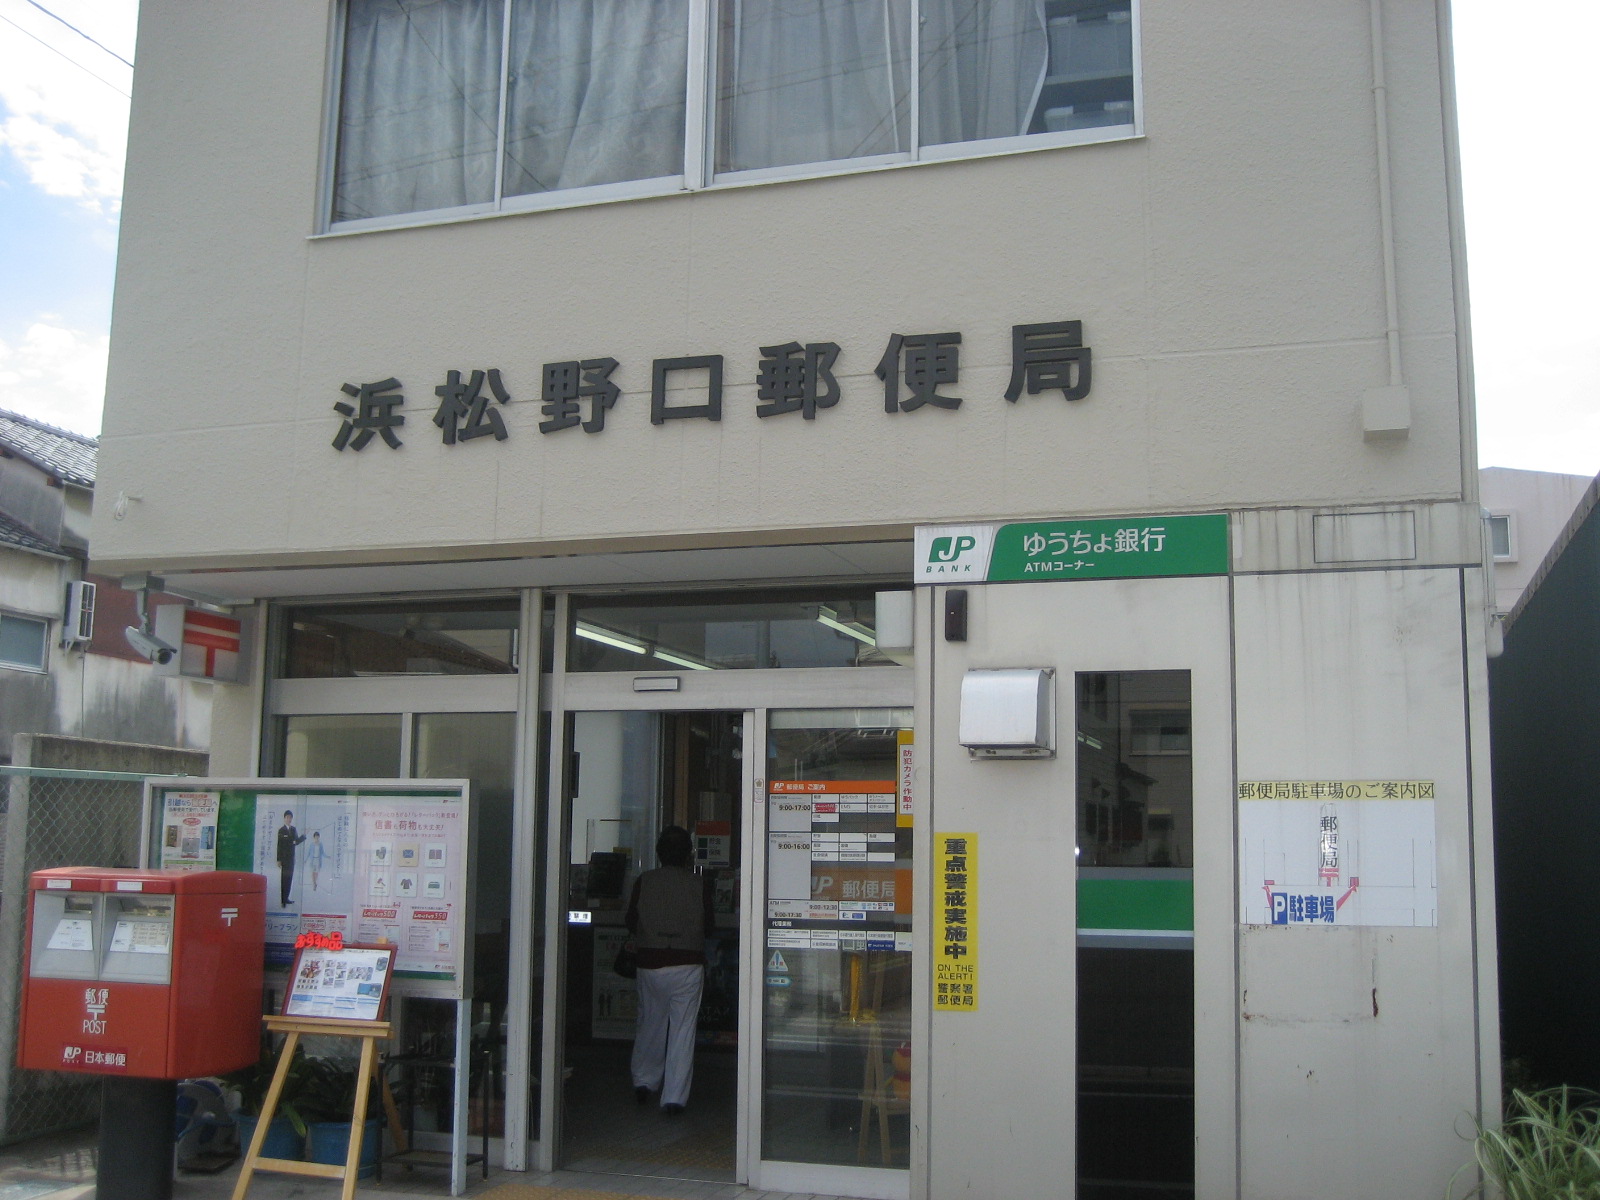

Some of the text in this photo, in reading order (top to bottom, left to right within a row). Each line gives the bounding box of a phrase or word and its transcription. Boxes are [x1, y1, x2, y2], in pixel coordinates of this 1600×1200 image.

[332, 320, 1092, 452] 浜松野口郵便局
[1023, 526, 1167, 557] ゆうちょ銀行
[925, 563, 972, 574] BANK
[1023, 560, 1095, 573] ATMコーナー
[903, 749, 913, 811] 防犯カメラ作動中
[1238, 781, 1435, 800] 郵便局駐車場のご案内図
[1319, 815, 1338, 868] 郵便局
[842, 879, 896, 899] 郵便局
[944, 838, 967, 960] 重点警戒実施中
[1288, 894, 1335, 924] 駐車場
[294, 930, 345, 951] おすすめ品
[937, 964, 974, 973] ON THE
[937, 972, 973, 981] ALERT!
[85, 988, 109, 1005] 郵便
[937, 983, 974, 994] 警察署
[937, 994, 974, 1006] 郵便局
[83, 1020, 107, 1035] POST
[85, 1050, 126, 1067] 日本郵便
